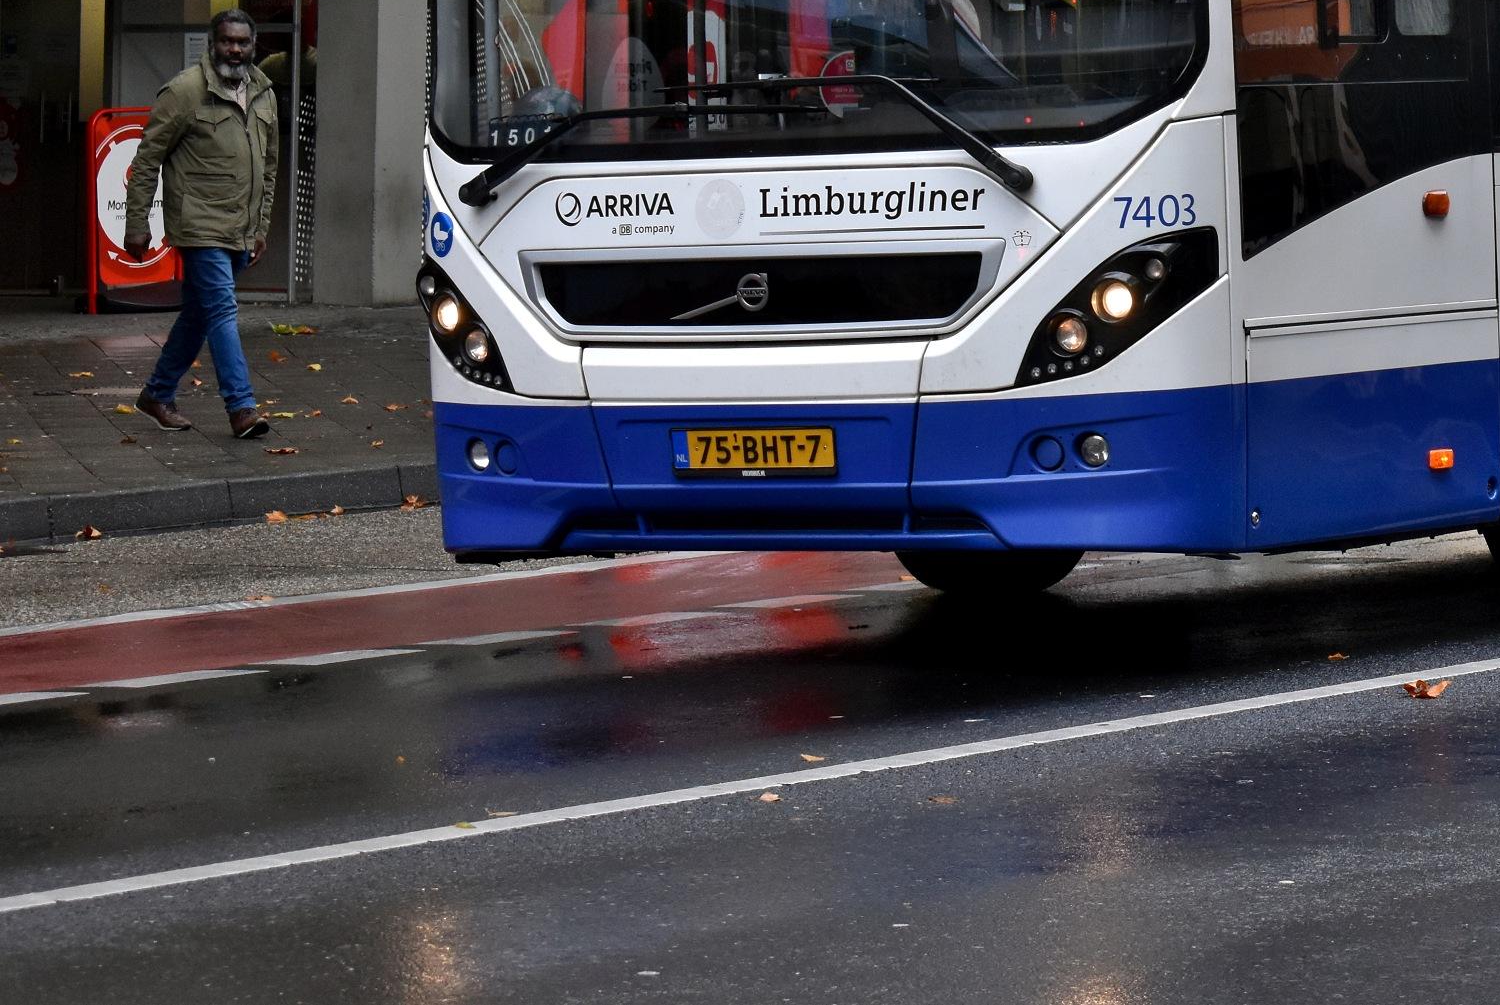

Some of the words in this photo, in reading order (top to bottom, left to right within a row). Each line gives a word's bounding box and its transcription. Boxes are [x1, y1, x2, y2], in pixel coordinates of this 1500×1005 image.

[586, 193, 674, 217] ARRIVA
[760, 182, 985, 220] Limburgliner
[1114, 194, 1196, 228] 7403
[612, 227, 617, 235] a
[619, 225, 633, 236] DB
[634, 224, 675, 236] company
[676, 454, 688, 463] NL
[697, 436, 821, 464] 75-BHT-7
